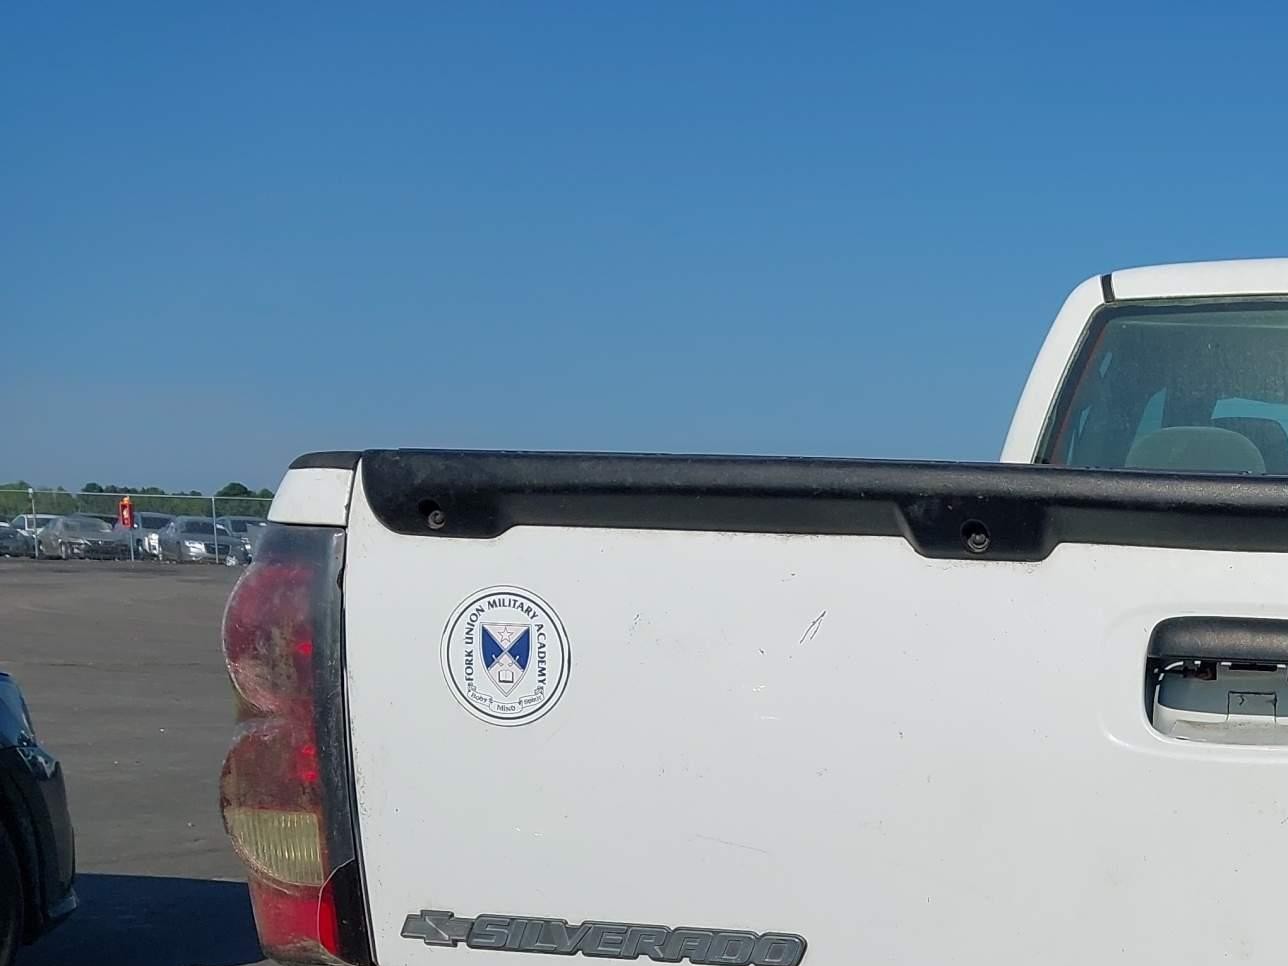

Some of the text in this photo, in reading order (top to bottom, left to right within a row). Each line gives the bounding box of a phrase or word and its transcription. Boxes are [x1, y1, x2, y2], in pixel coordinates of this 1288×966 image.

[464, 598, 547, 686] FORK UNION MILITARY ACADEMY
